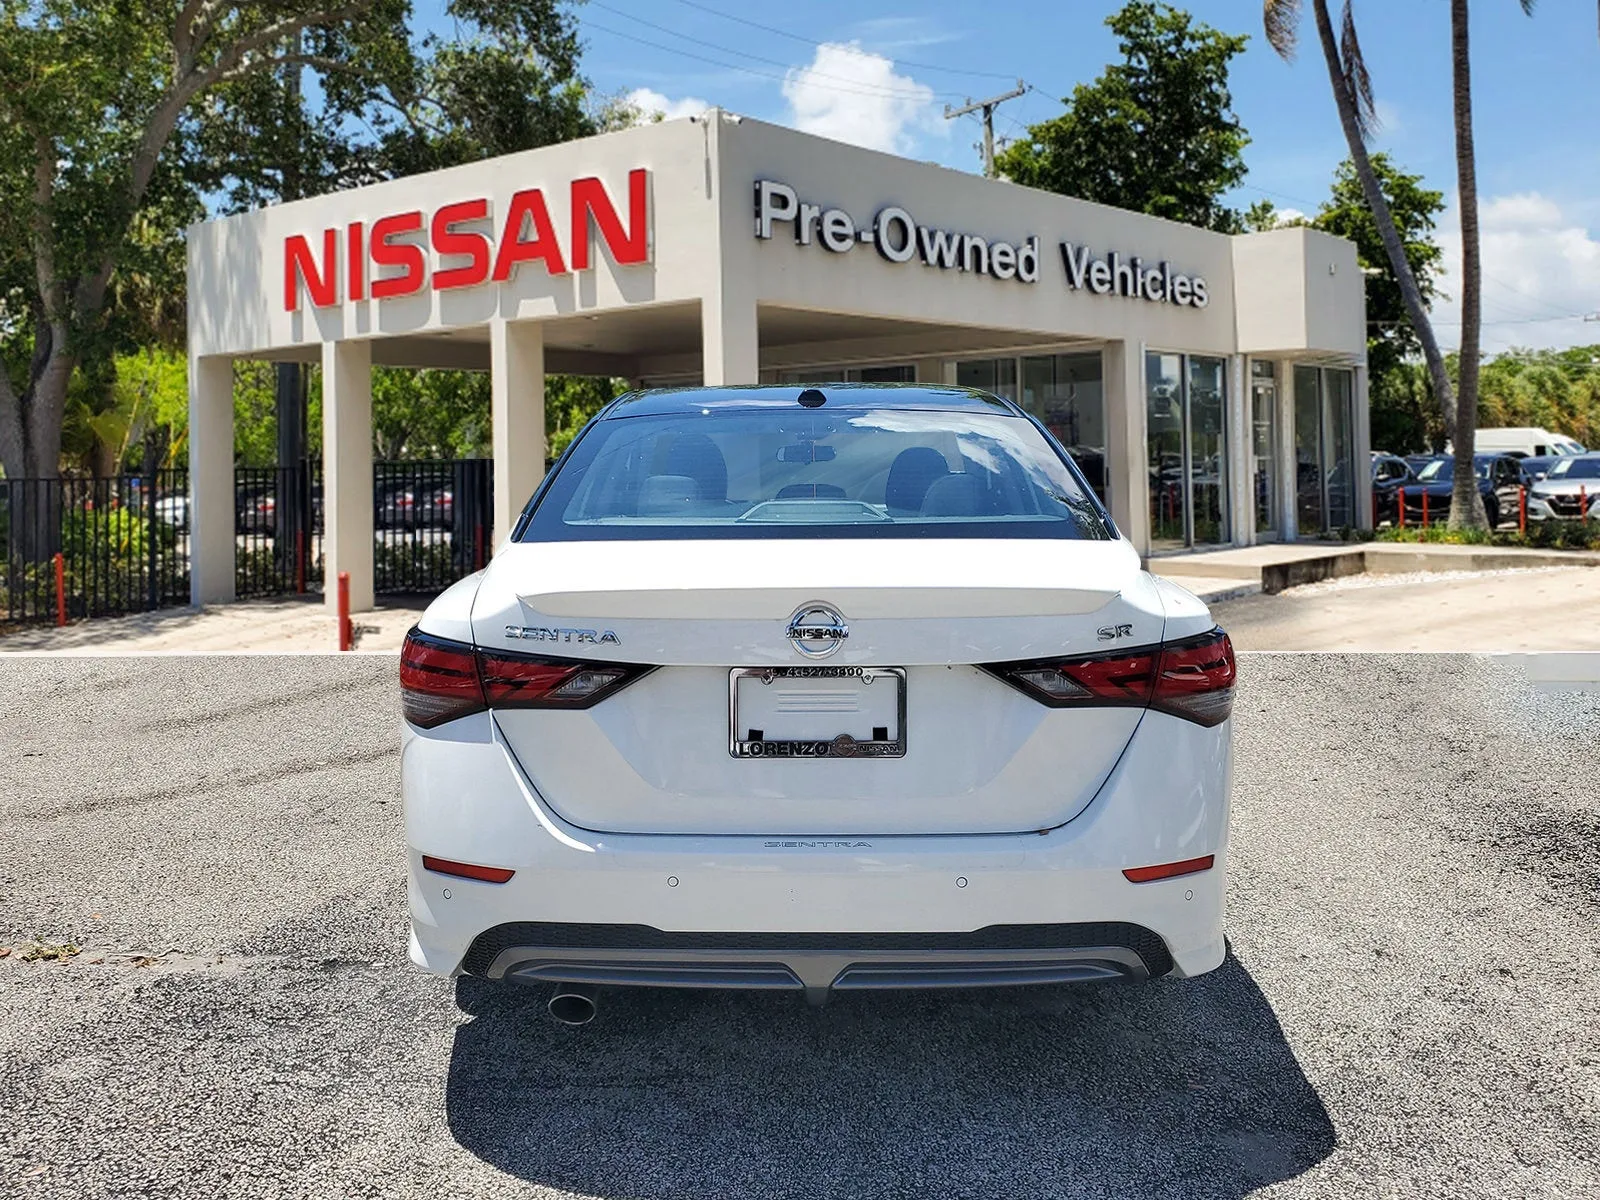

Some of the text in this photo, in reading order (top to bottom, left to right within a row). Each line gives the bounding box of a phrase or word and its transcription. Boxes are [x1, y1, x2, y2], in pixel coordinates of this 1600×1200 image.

[285, 168, 647, 312] NISSAN
[755, 179, 1209, 308] Pre-Owned Vehicles
[504, 625, 621, 645] SENTRA
[790, 627, 844, 639] NISSAN
[1096, 623, 1134, 642] SR
[737, 741, 829, 756] LORENZO
[858, 743, 899, 754] NISSAN
[764, 840, 873, 848] SENTRA
